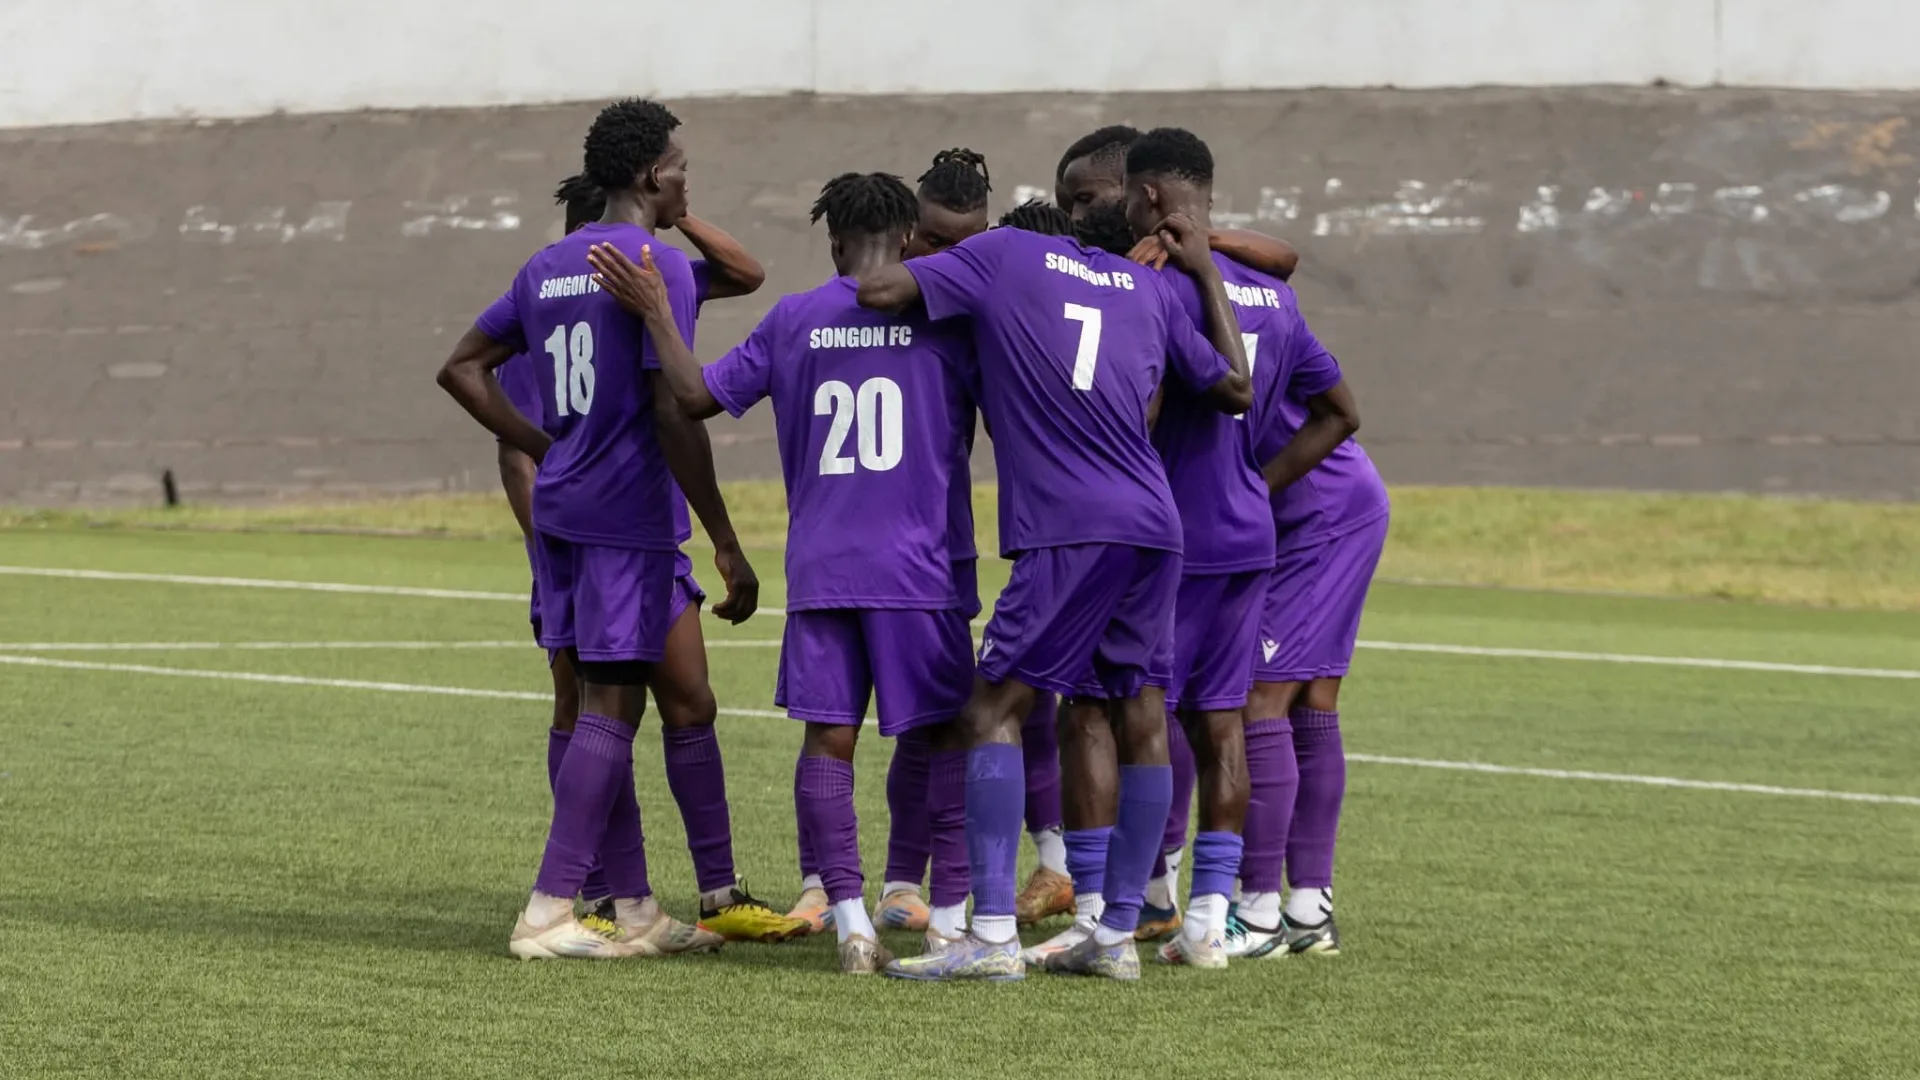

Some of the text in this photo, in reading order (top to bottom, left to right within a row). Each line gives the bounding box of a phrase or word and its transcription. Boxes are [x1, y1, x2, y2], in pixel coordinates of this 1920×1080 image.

[539, 275, 588, 299] SONGON
[1045, 252, 1135, 290] SONGON FC
[809, 325, 912, 349] SONGON FC
[1064, 302, 1102, 391] 7
[544, 321, 595, 417] 18
[814, 377, 903, 475] 20
